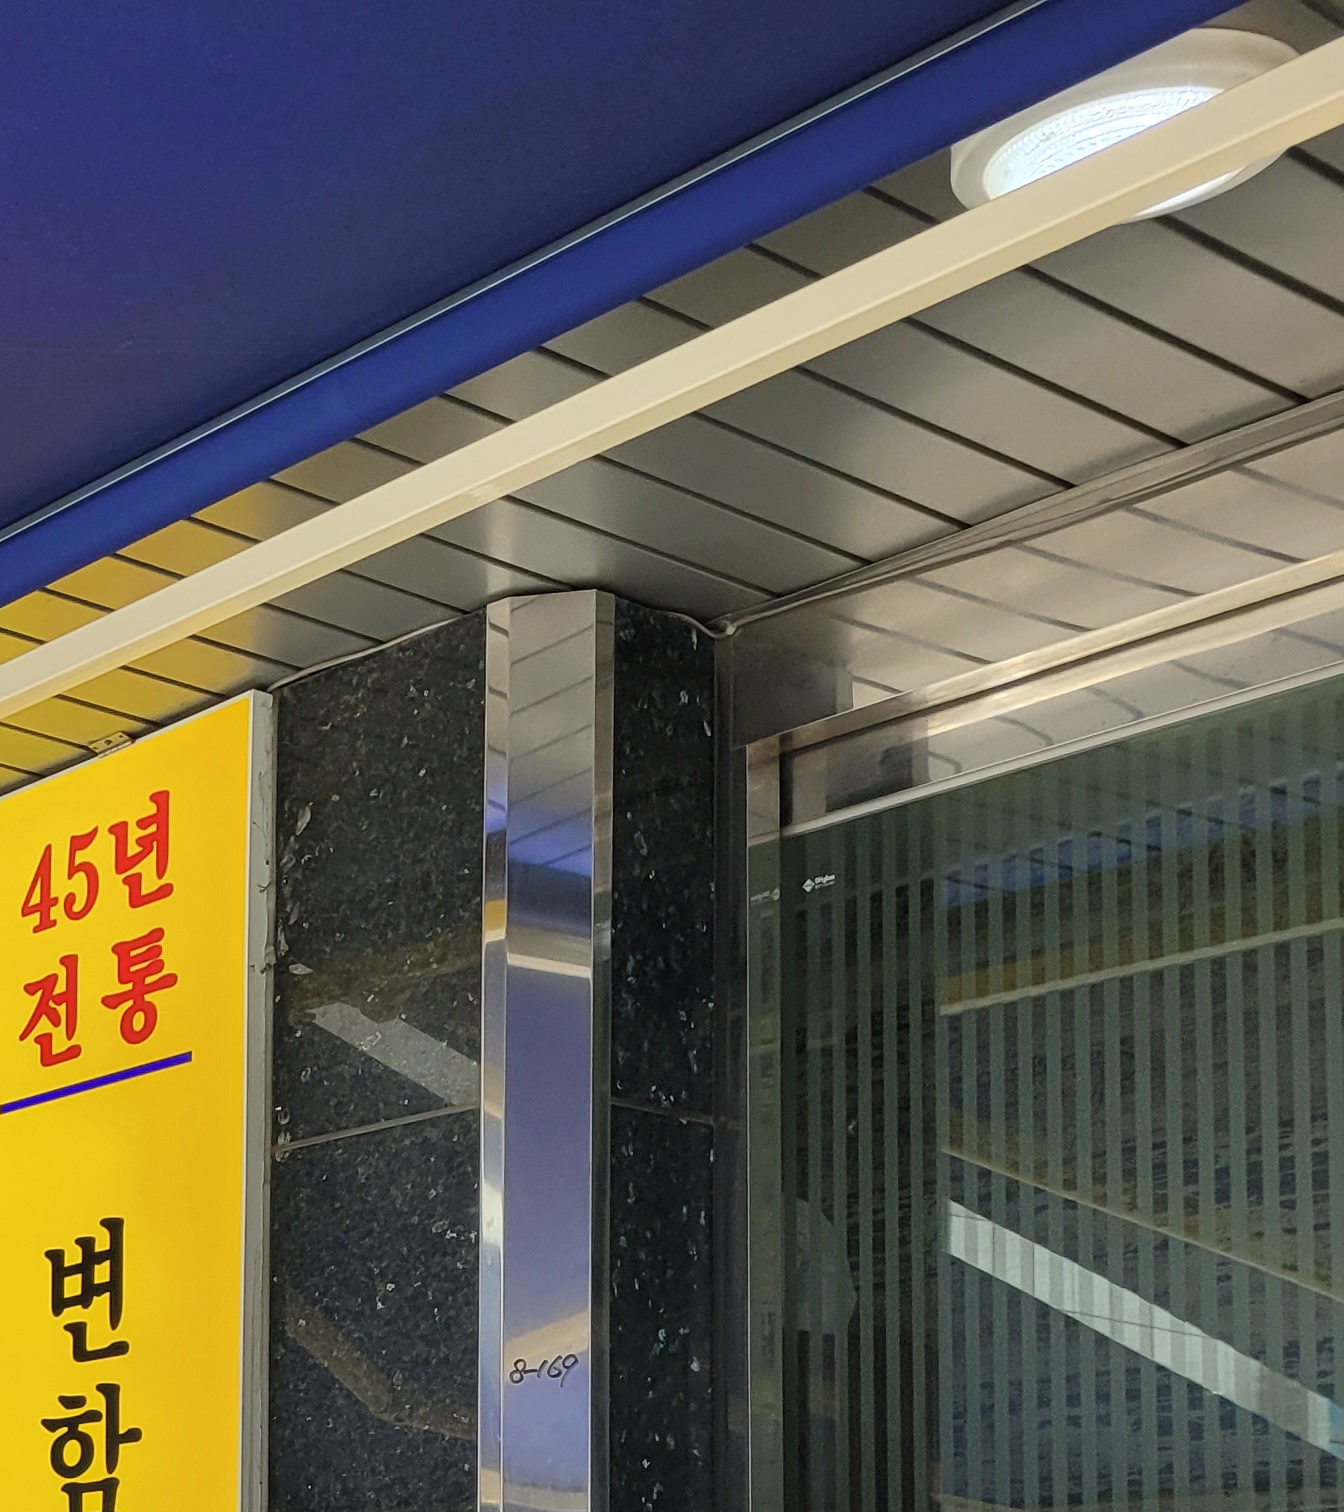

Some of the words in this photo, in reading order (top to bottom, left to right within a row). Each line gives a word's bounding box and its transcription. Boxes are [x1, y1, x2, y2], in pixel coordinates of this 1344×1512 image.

[20, 789, 176, 935] 45년
[18, 926, 179, 1068] 전통
[509, 1354, 578, 1388] 8-169
